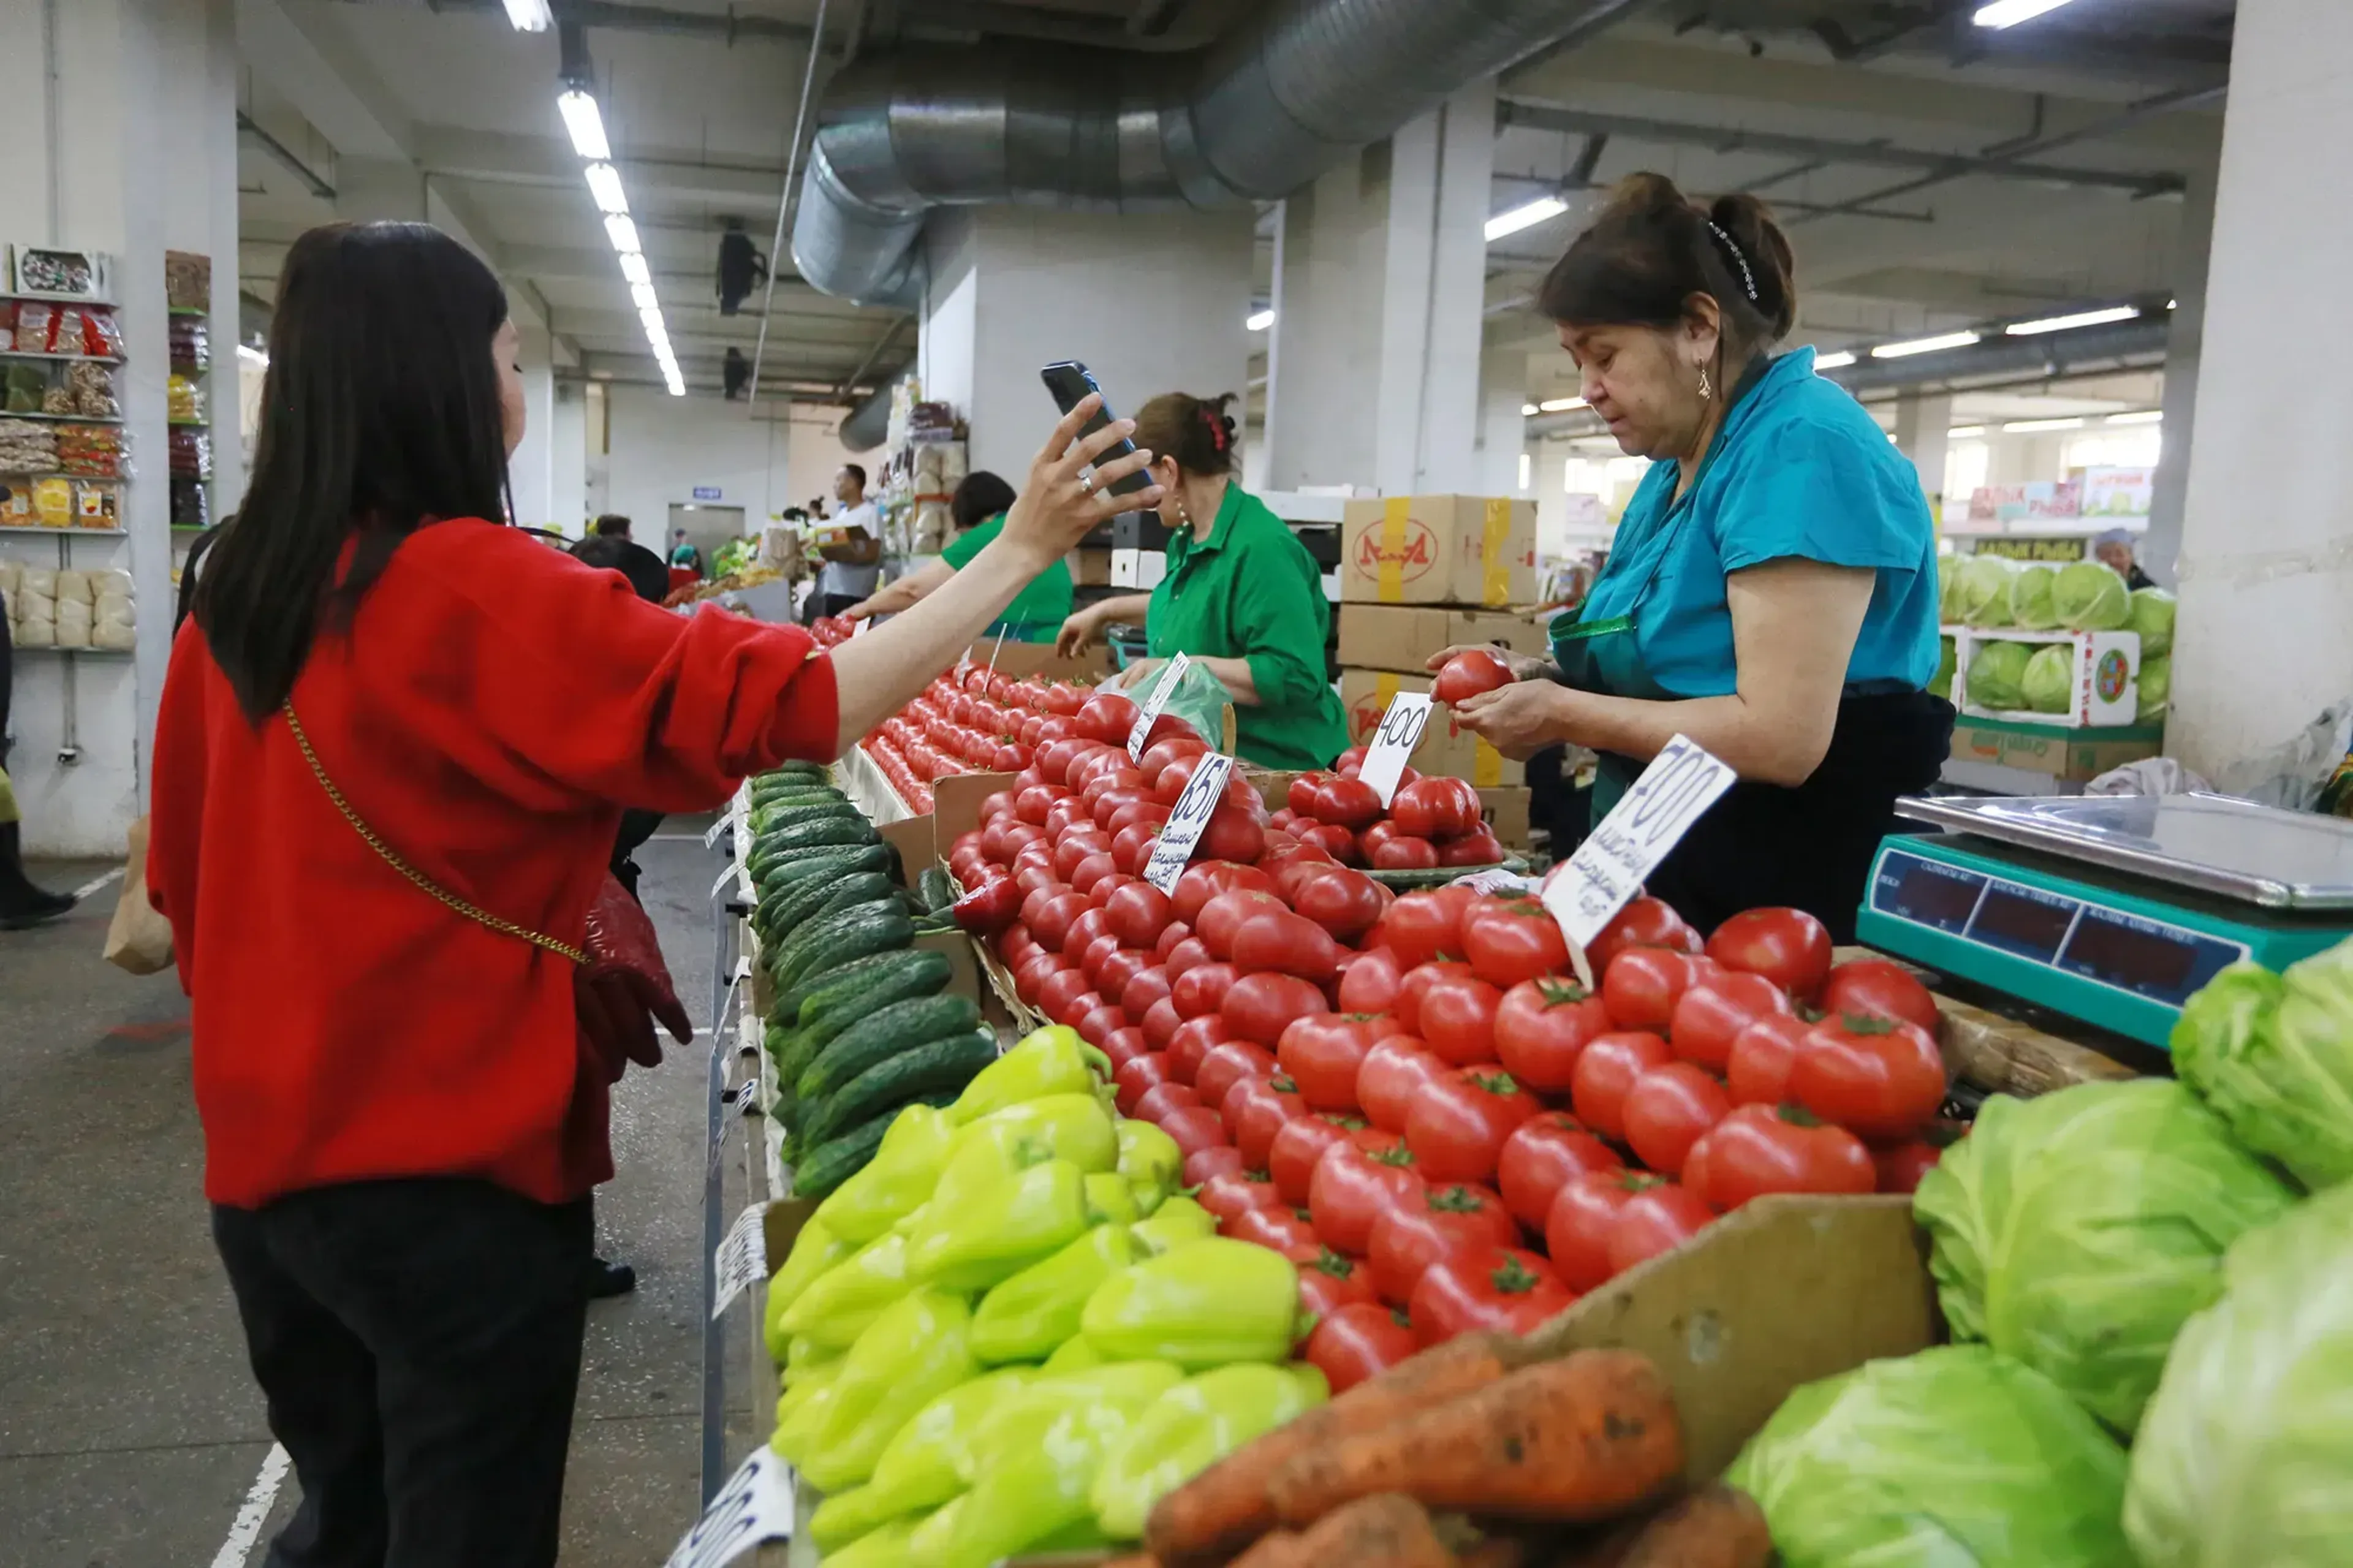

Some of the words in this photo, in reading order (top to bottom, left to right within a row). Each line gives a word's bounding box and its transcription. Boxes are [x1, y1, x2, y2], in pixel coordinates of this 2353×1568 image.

[1379, 694, 1426, 748] 400
[1172, 756, 1230, 824] 650
[1617, 743, 1720, 847] 700
